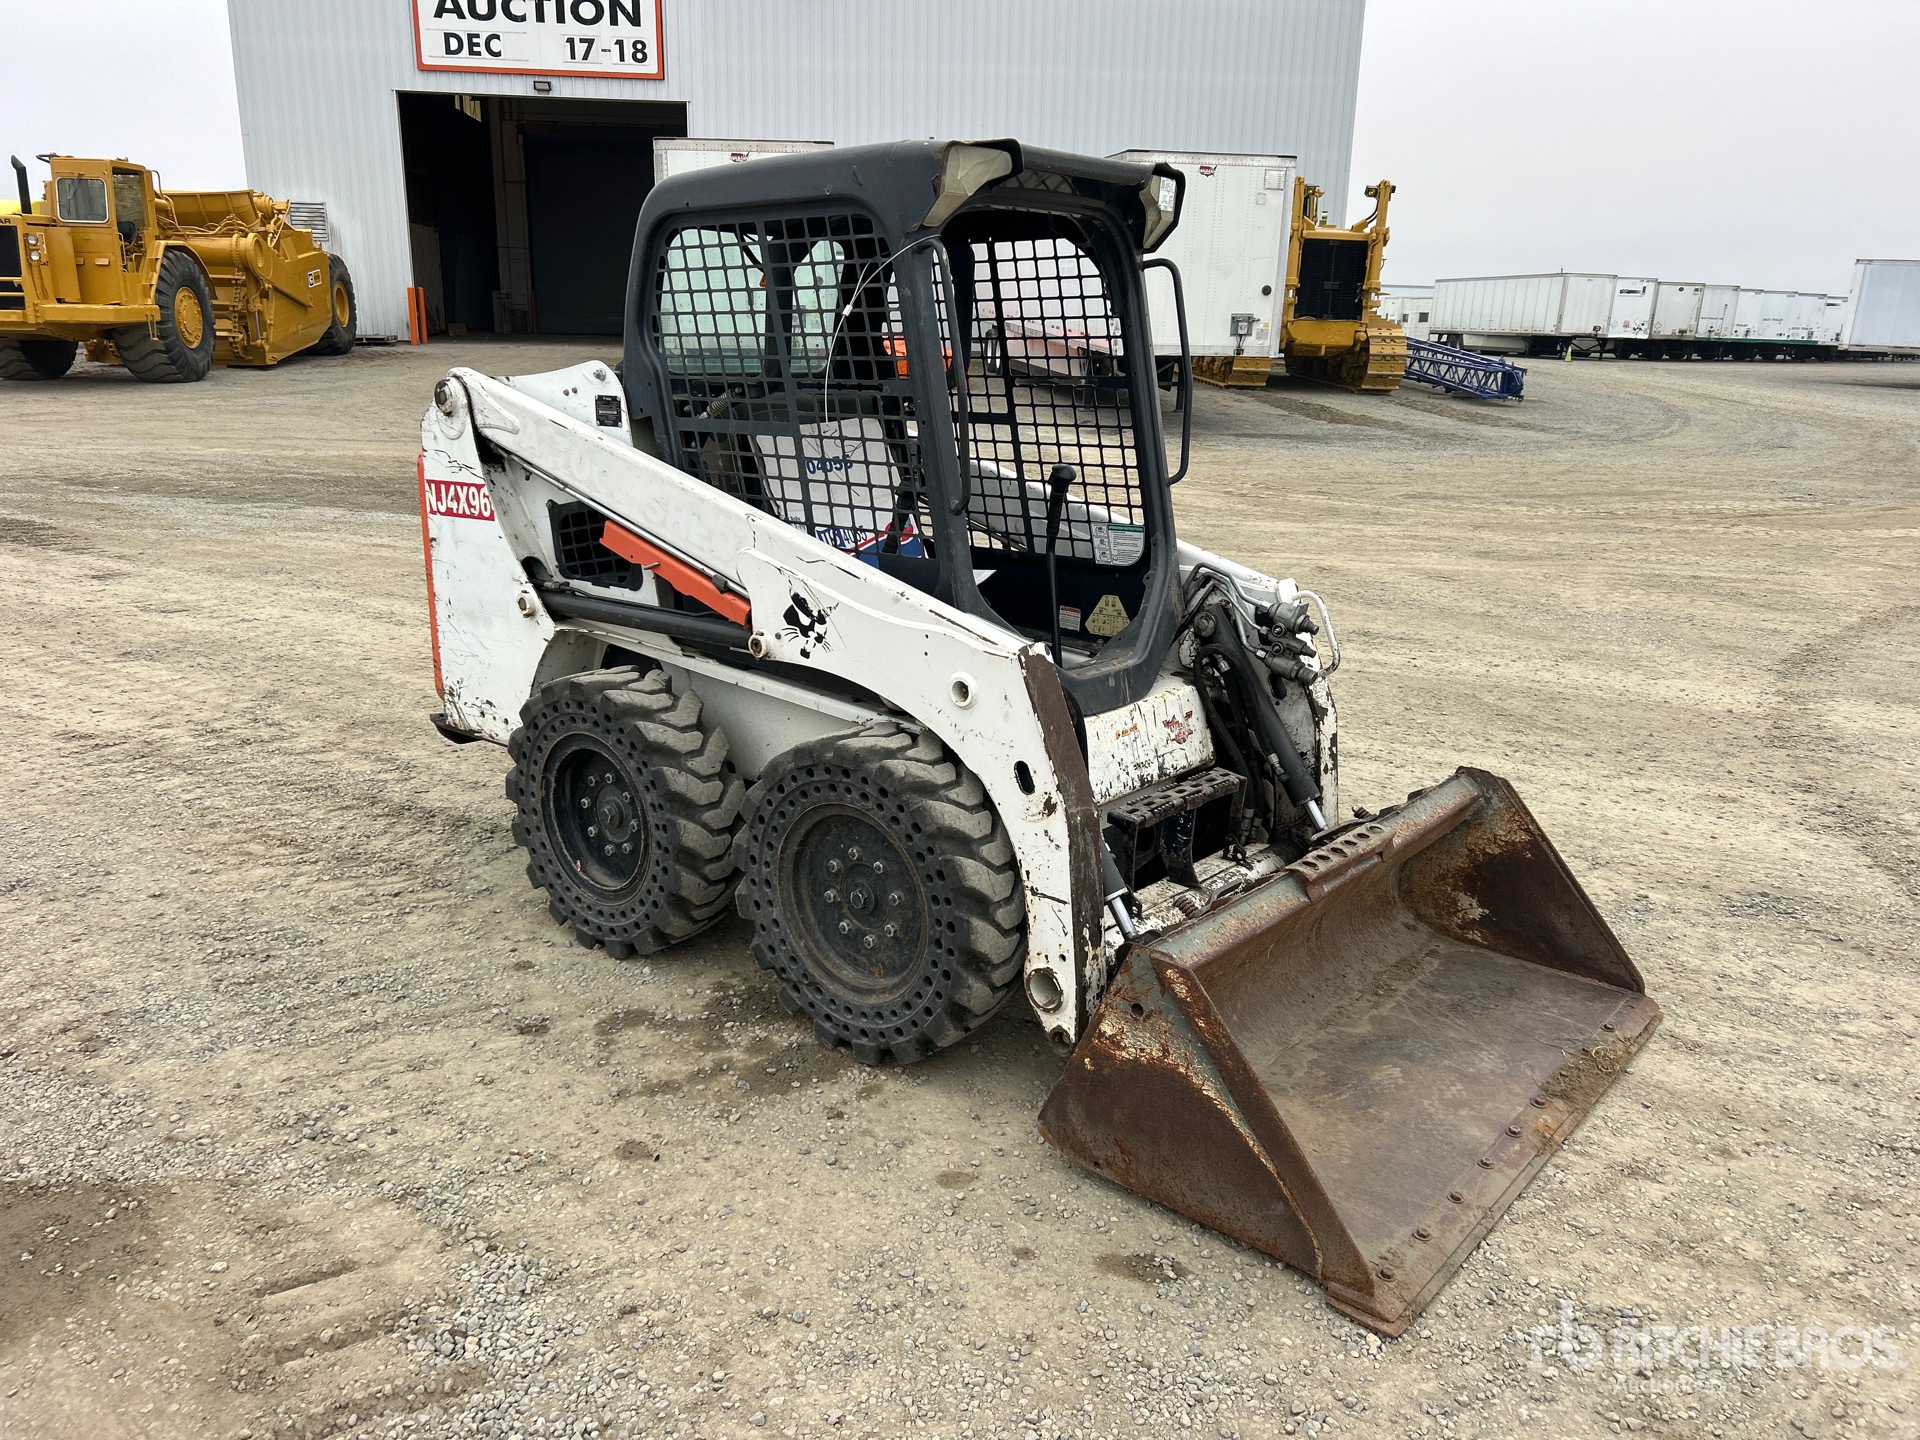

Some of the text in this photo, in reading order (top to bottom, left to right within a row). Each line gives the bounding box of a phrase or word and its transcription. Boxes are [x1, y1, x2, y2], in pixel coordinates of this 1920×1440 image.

[433, 0, 642, 28] AUCTION
[443, 31, 649, 64] DEC 17-18
